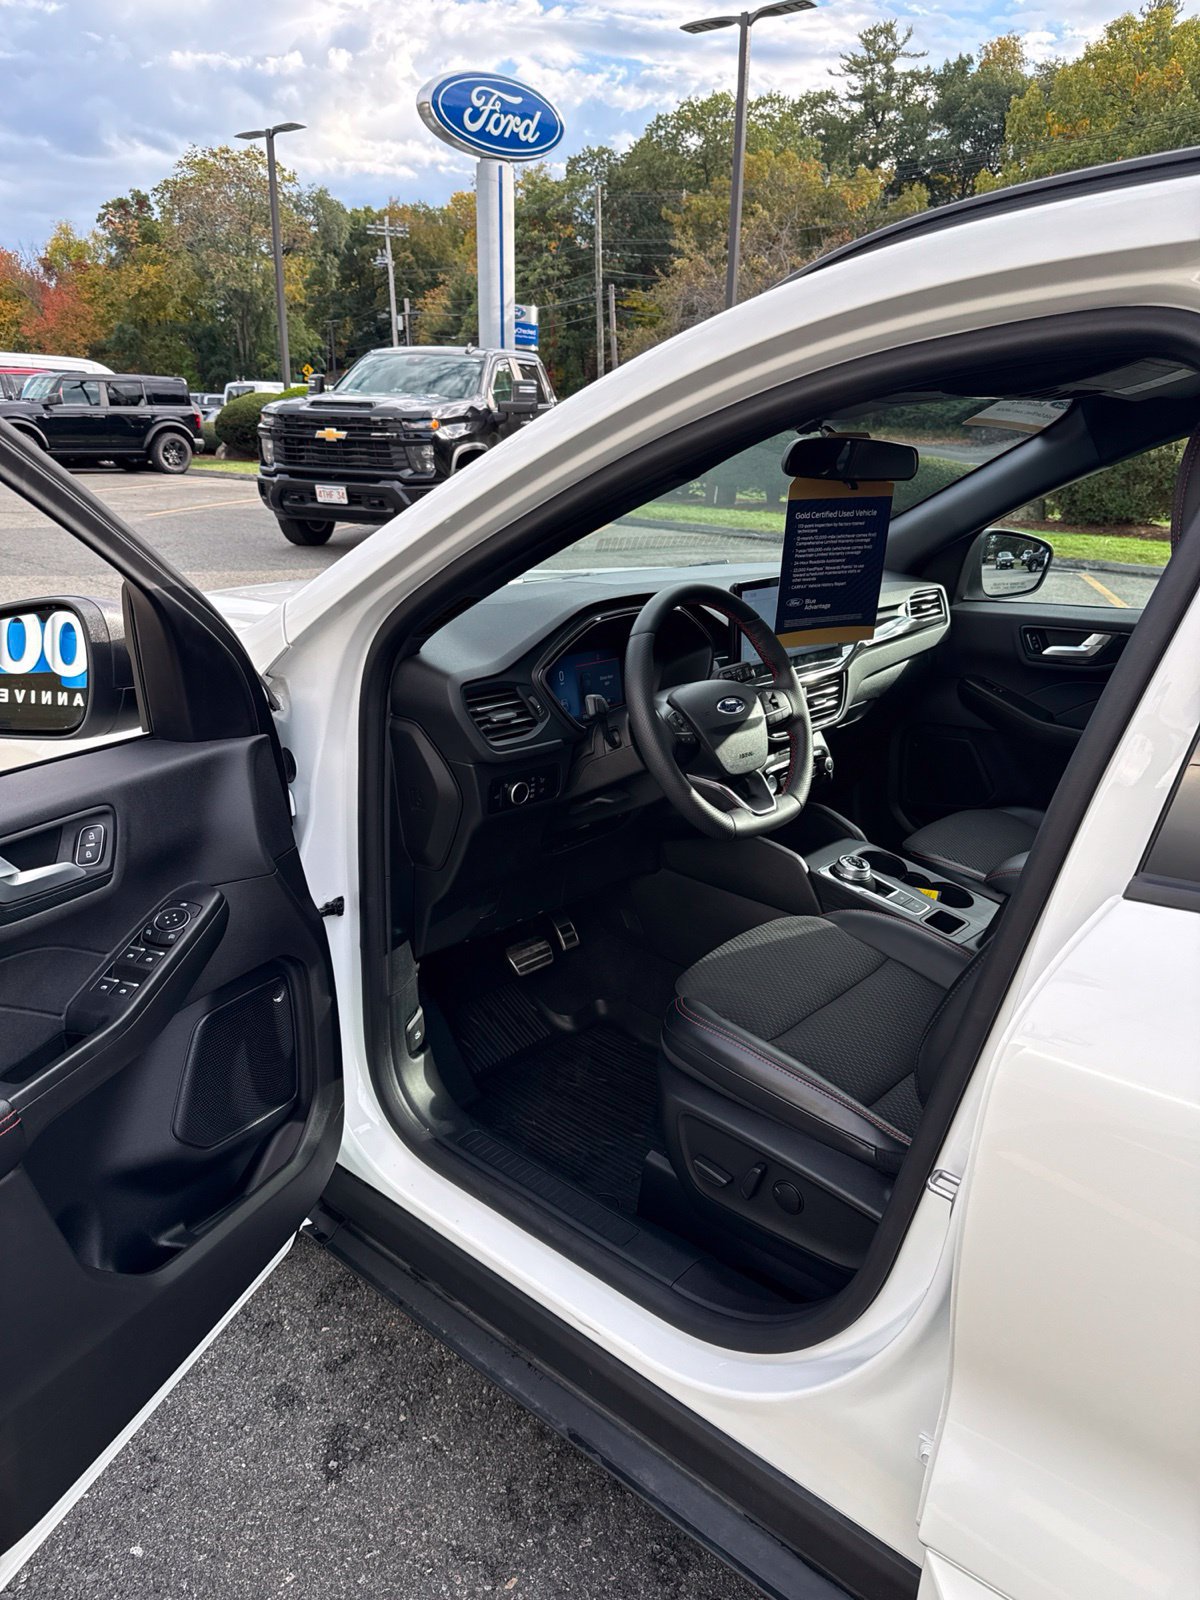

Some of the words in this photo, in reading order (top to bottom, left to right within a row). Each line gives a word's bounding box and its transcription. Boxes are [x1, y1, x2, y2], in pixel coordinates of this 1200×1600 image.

[463, 86, 542, 143] Ford
[811, 510, 838, 519] Certified
[839, 510, 855, 518] Used
[855, 509, 877, 517] Vehicle
